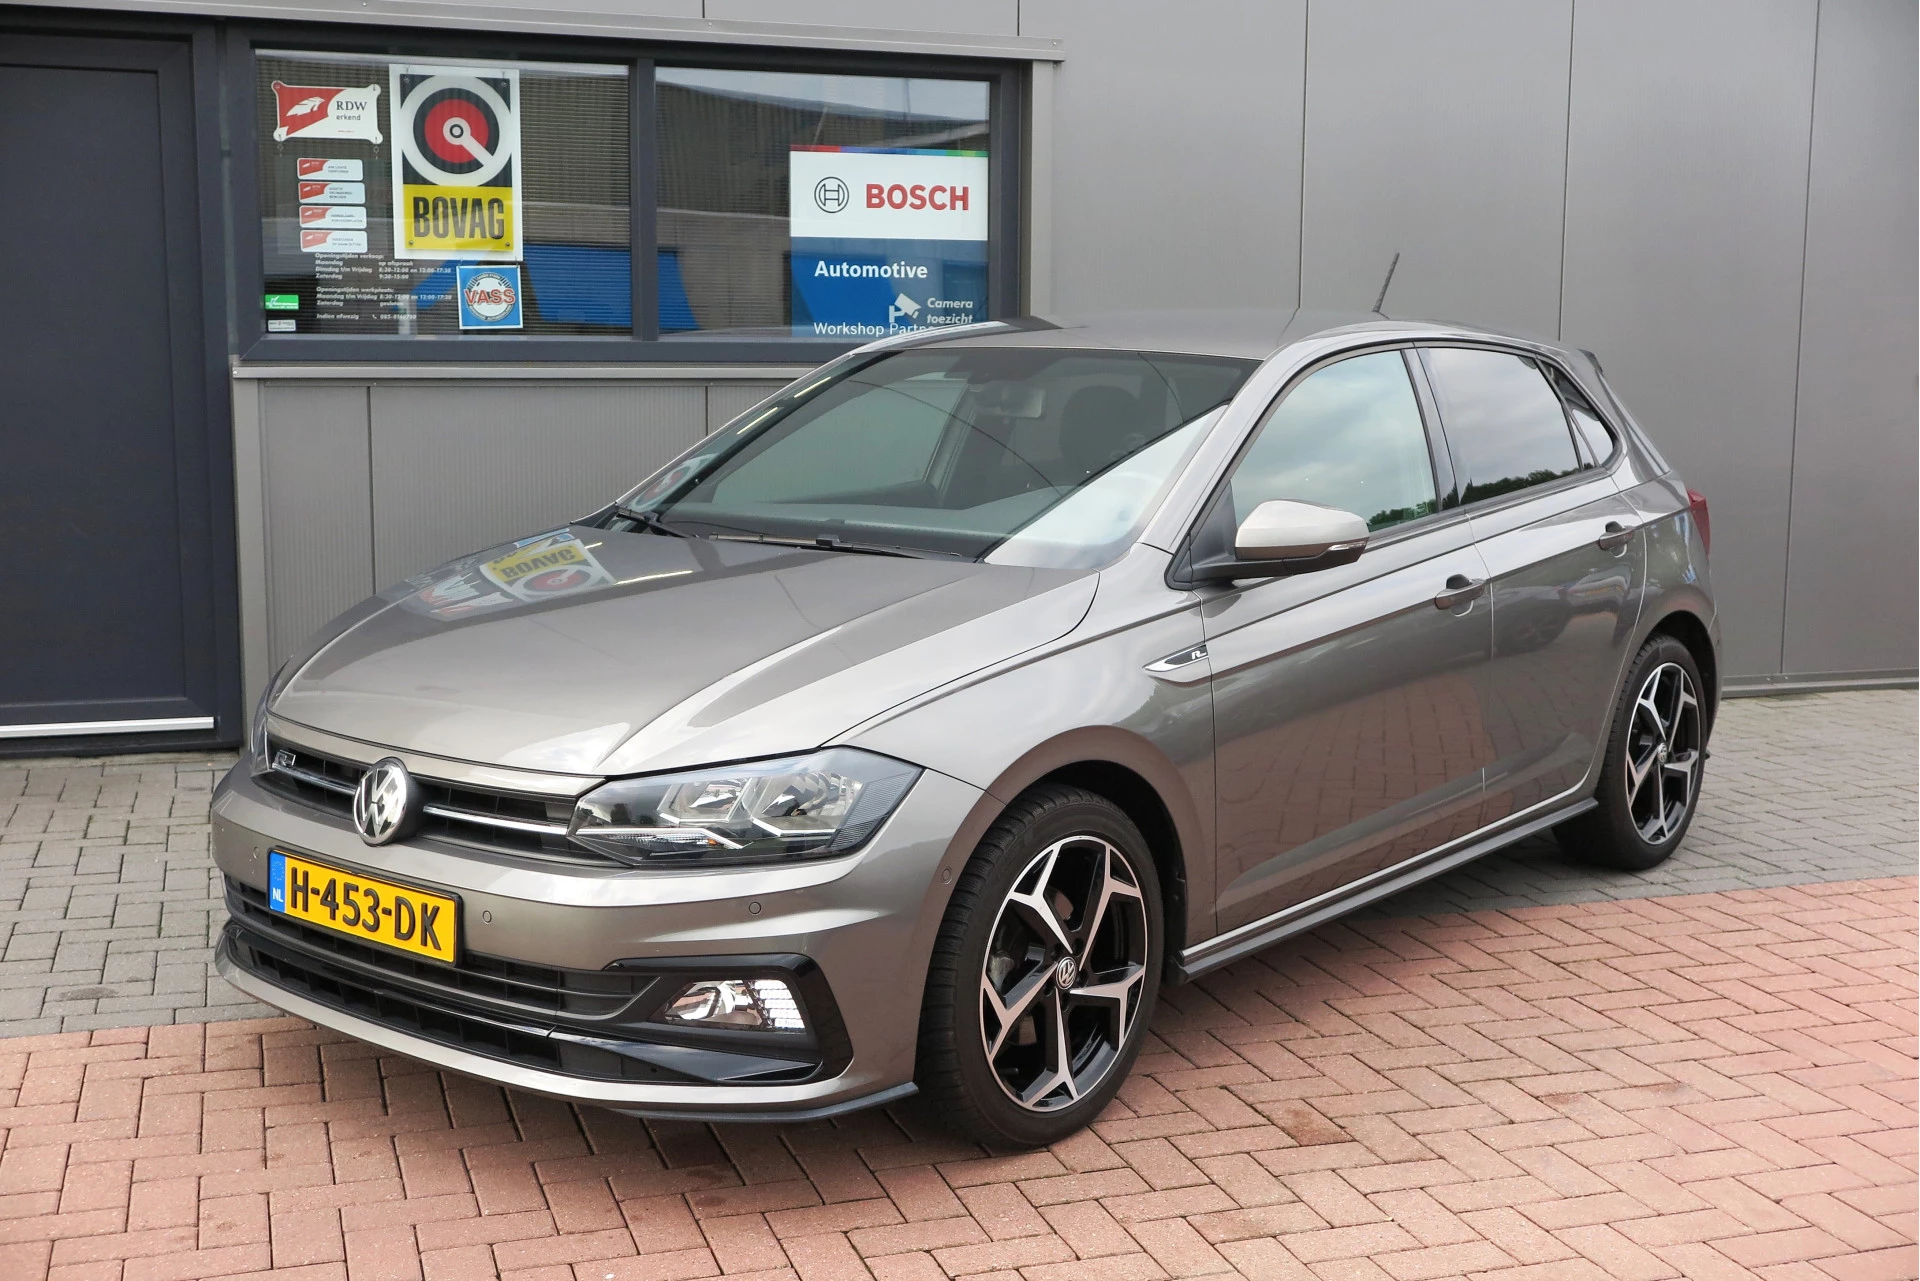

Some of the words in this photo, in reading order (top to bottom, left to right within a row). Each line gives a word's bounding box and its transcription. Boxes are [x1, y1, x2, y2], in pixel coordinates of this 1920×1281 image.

[336, 101, 368, 111] RDW
[336, 113, 361, 121] erkend
[866, 183, 970, 211] BOSCH
[413, 196, 505, 240] BOVAG
[814, 260, 929, 279] Automotive
[464, 287, 516, 305] VASS
[927, 297, 974, 310] Camera
[927, 312, 974, 325] toezicht
[814, 322, 885, 338] Workshop
[272, 887, 284, 903] NL
[291, 866, 442, 951] H-453-DK
